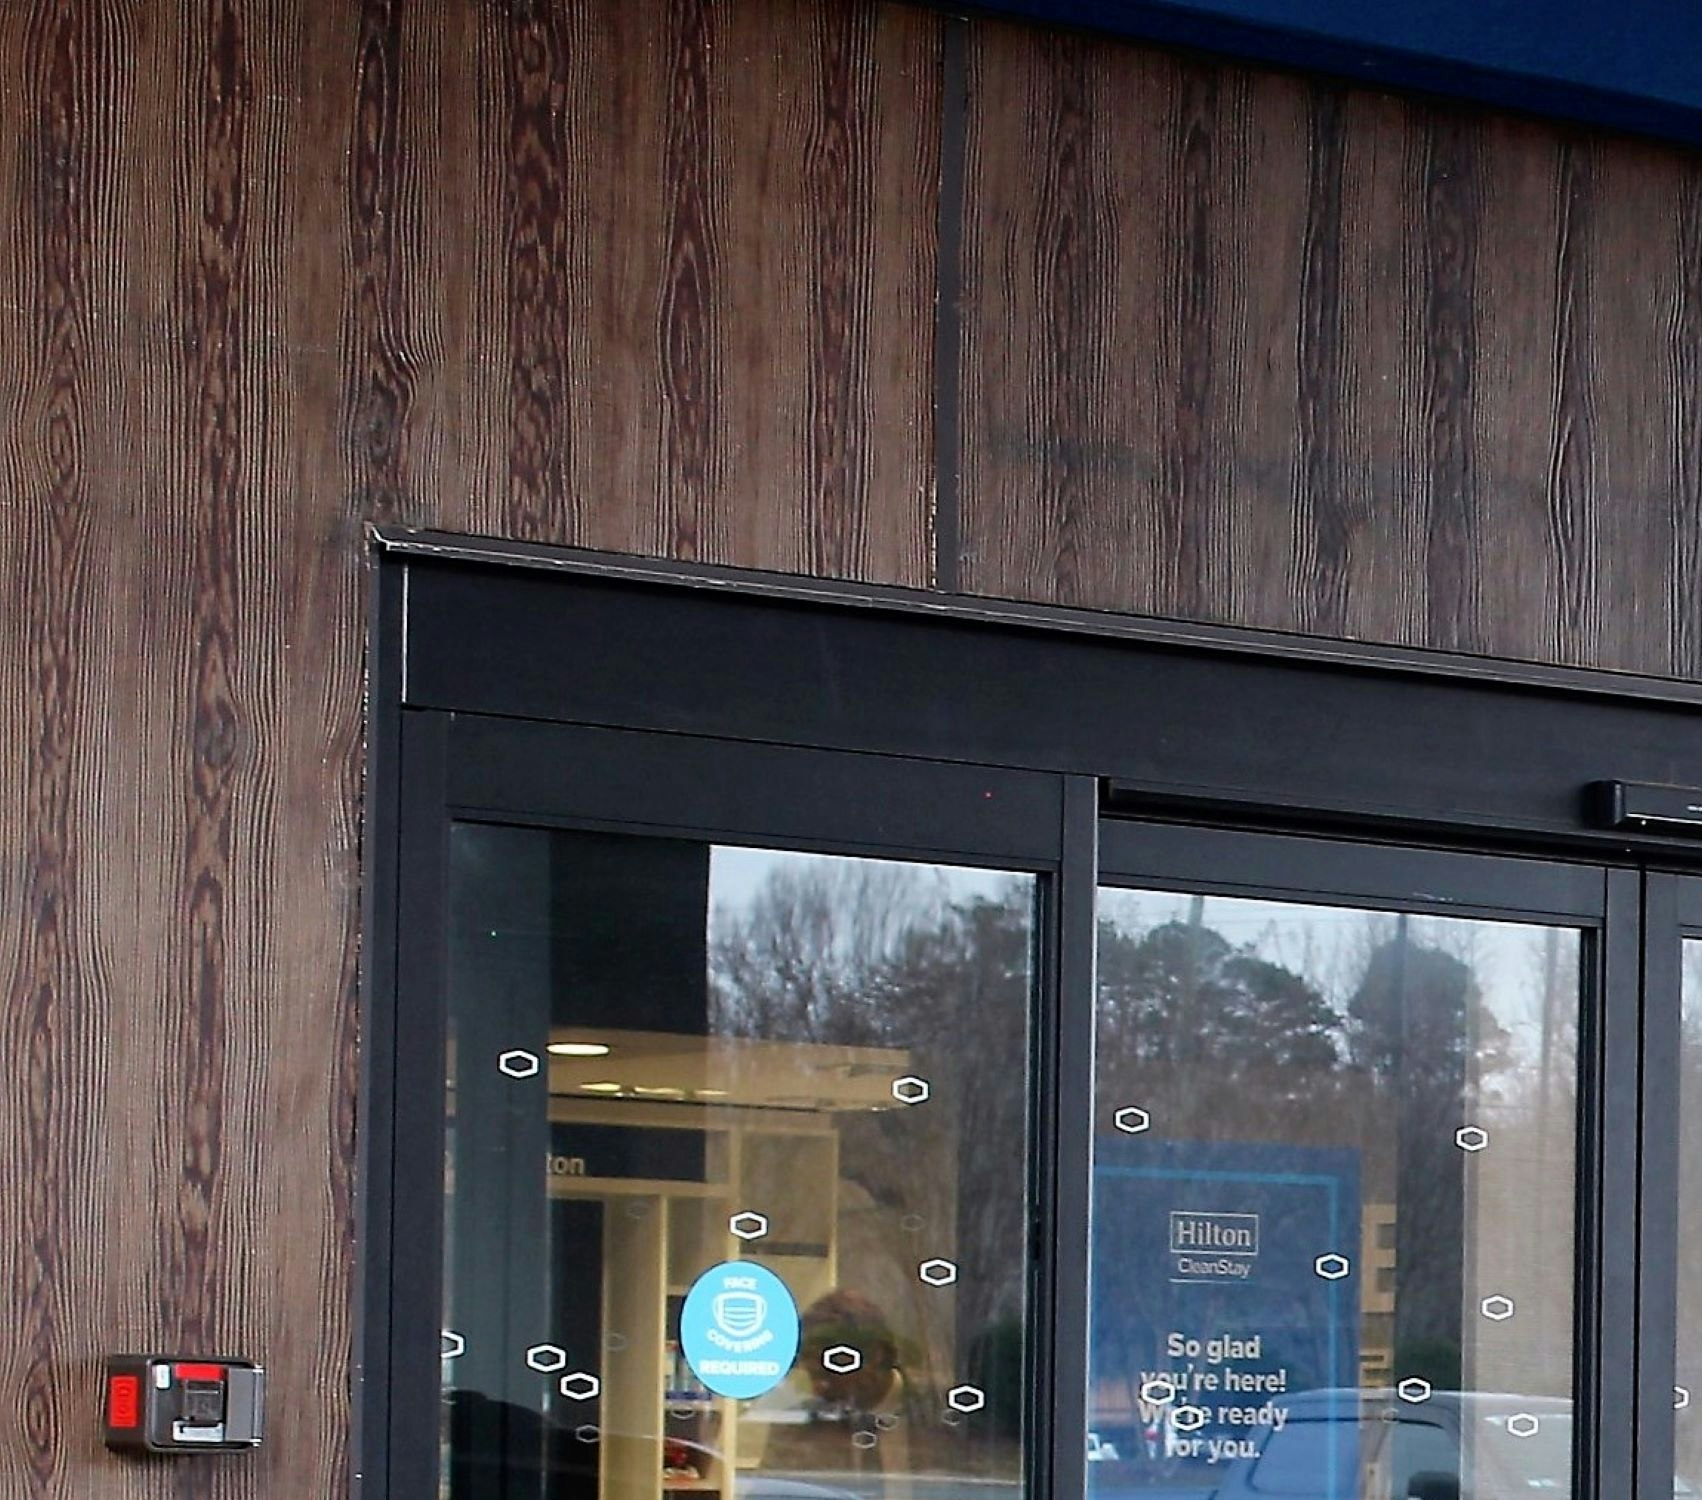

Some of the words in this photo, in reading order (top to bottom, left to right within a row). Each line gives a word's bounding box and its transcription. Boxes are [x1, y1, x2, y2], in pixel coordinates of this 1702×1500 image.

[1178, 1220, 1251, 1247] Hilton
[1178, 1257, 1251, 1279] CleanStay
[723, 1276, 757, 1290] FACE
[706, 1327, 775, 1353] COVERING
[1168, 1333, 1199, 1359] So
[1207, 1334, 1261, 1364] glad
[700, 1360, 780, 1375] REQUIRED
[1225, 1368, 1286, 1393] here!
[1138, 1397, 1212, 1425] W'e
[1219, 1401, 1288, 1432] ready
[1165, 1434, 1203, 1458] for
[1207, 1438, 1261, 1465] you.
